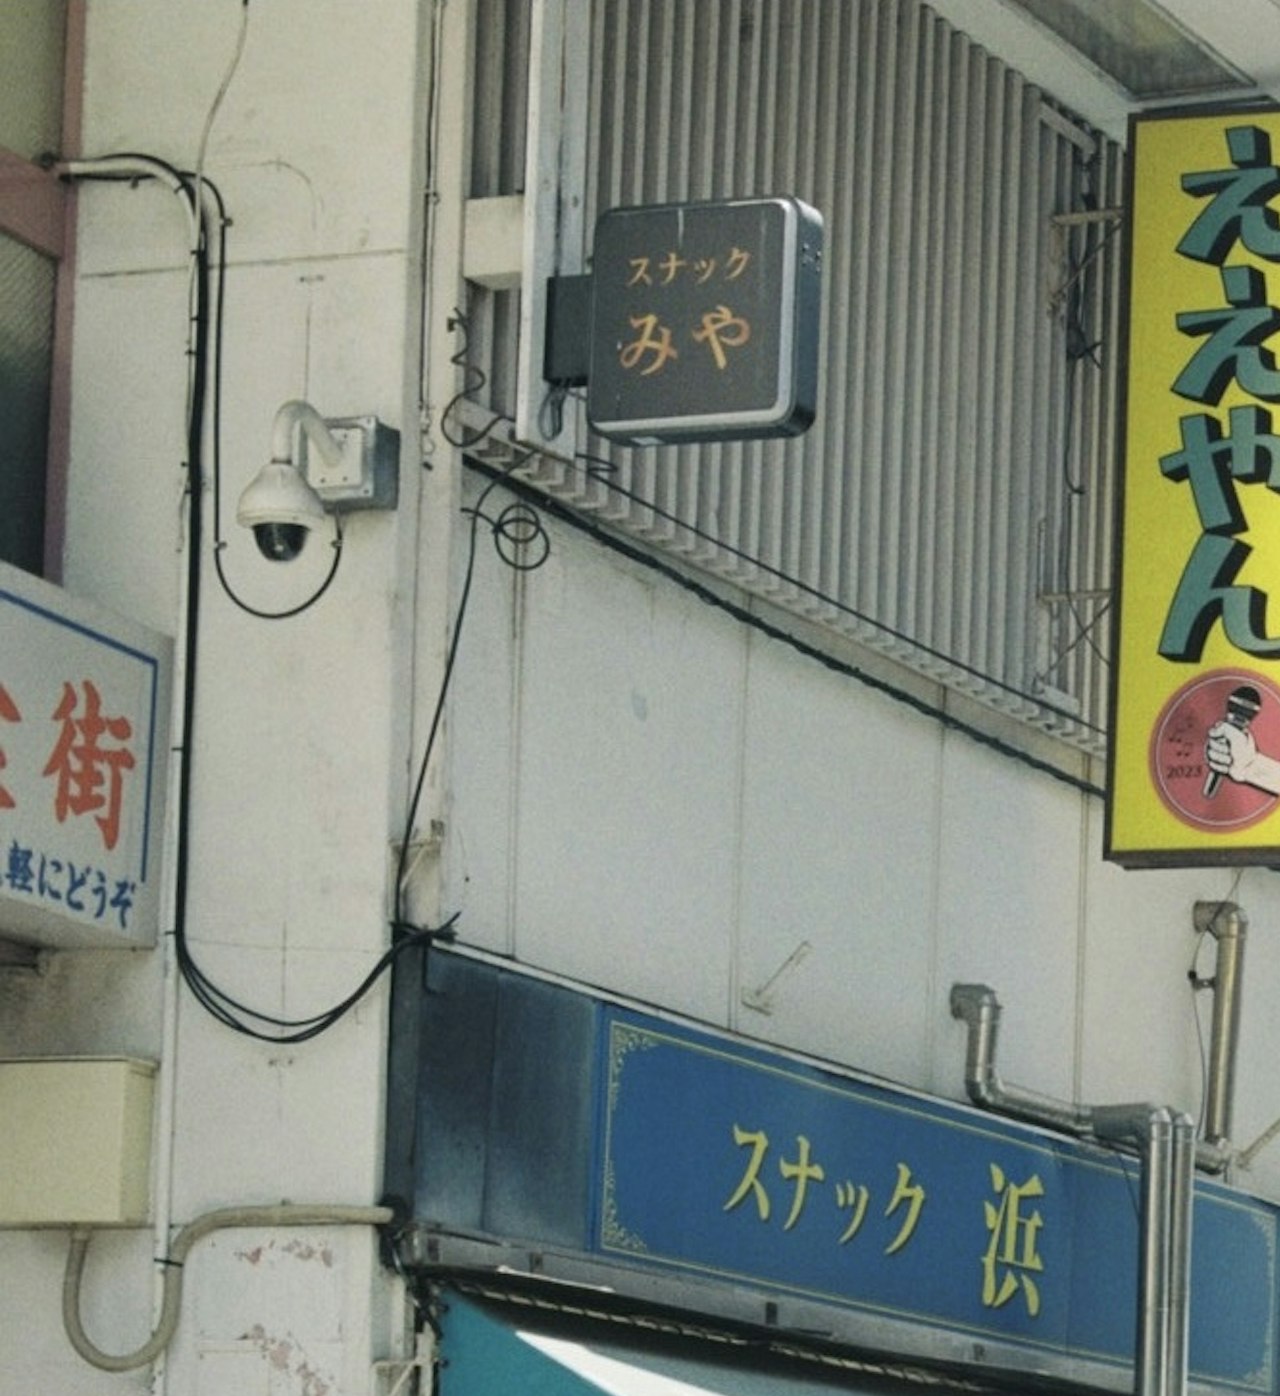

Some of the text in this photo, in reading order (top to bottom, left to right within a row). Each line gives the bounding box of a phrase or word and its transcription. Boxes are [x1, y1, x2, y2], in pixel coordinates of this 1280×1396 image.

[626, 248, 750, 287] スナック
[620, 305, 750, 376] みや
[0, 841, 137, 930] 軽にどうぞ
[723, 1122, 1044, 1318] スナック 浜
